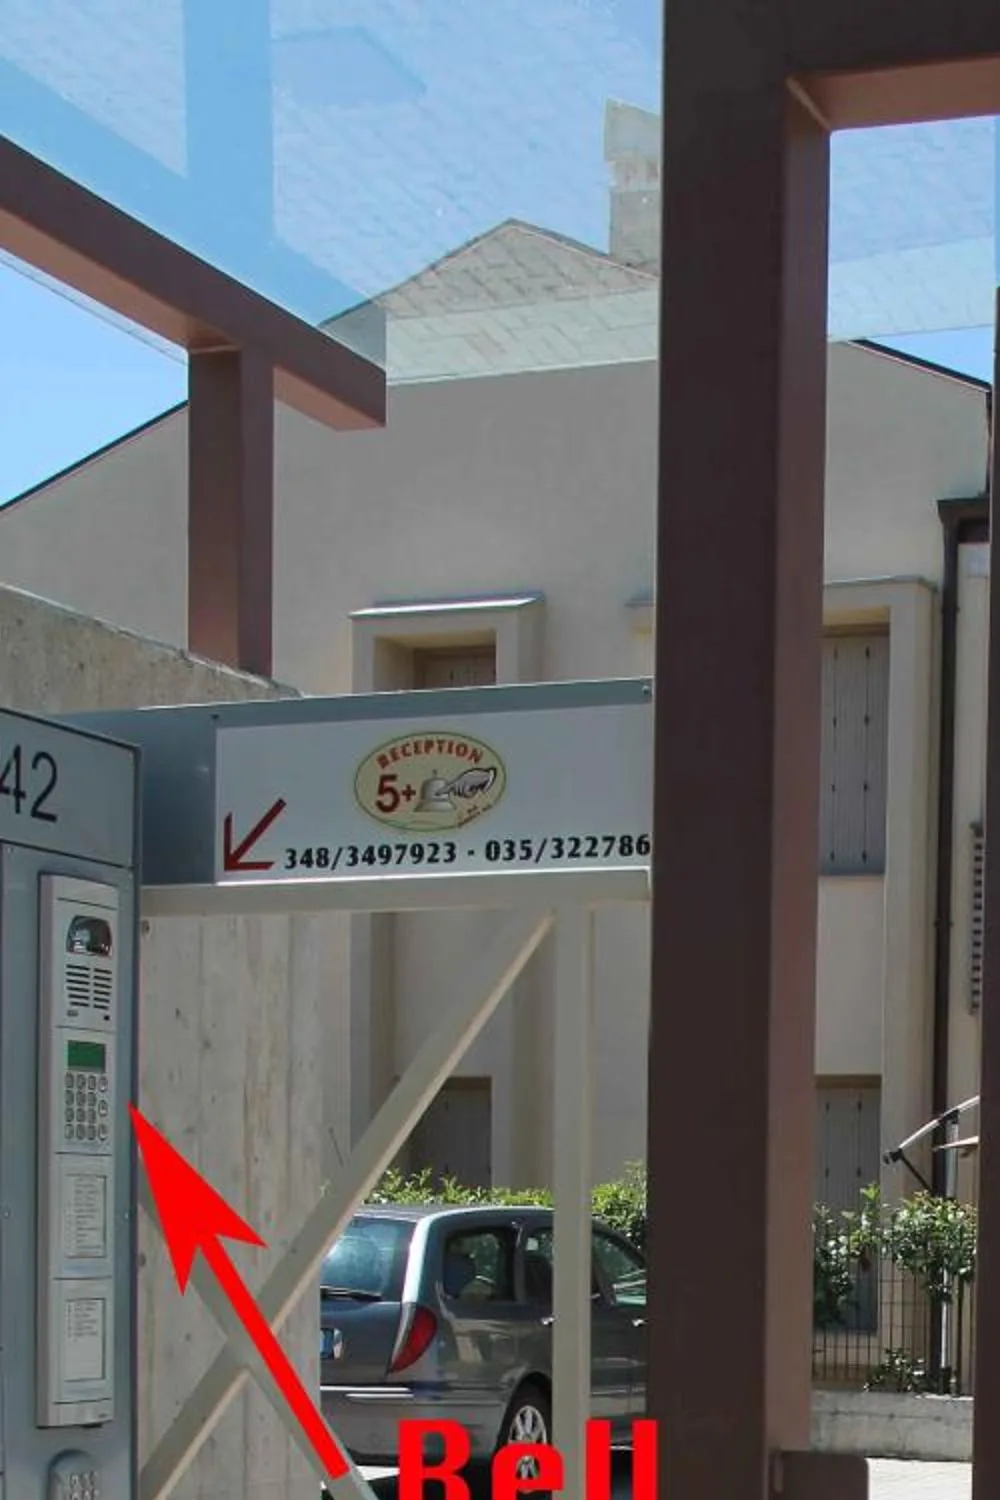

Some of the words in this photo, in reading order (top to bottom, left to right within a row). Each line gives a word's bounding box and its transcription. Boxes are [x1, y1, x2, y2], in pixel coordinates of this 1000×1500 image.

[375, 737, 483, 770] RECEPTION
[0, 744, 58, 823] 42
[375, 773, 417, 814] 5+
[284, 841, 457, 871] 348/3497923
[485, 833, 651, 864] 035/322786
